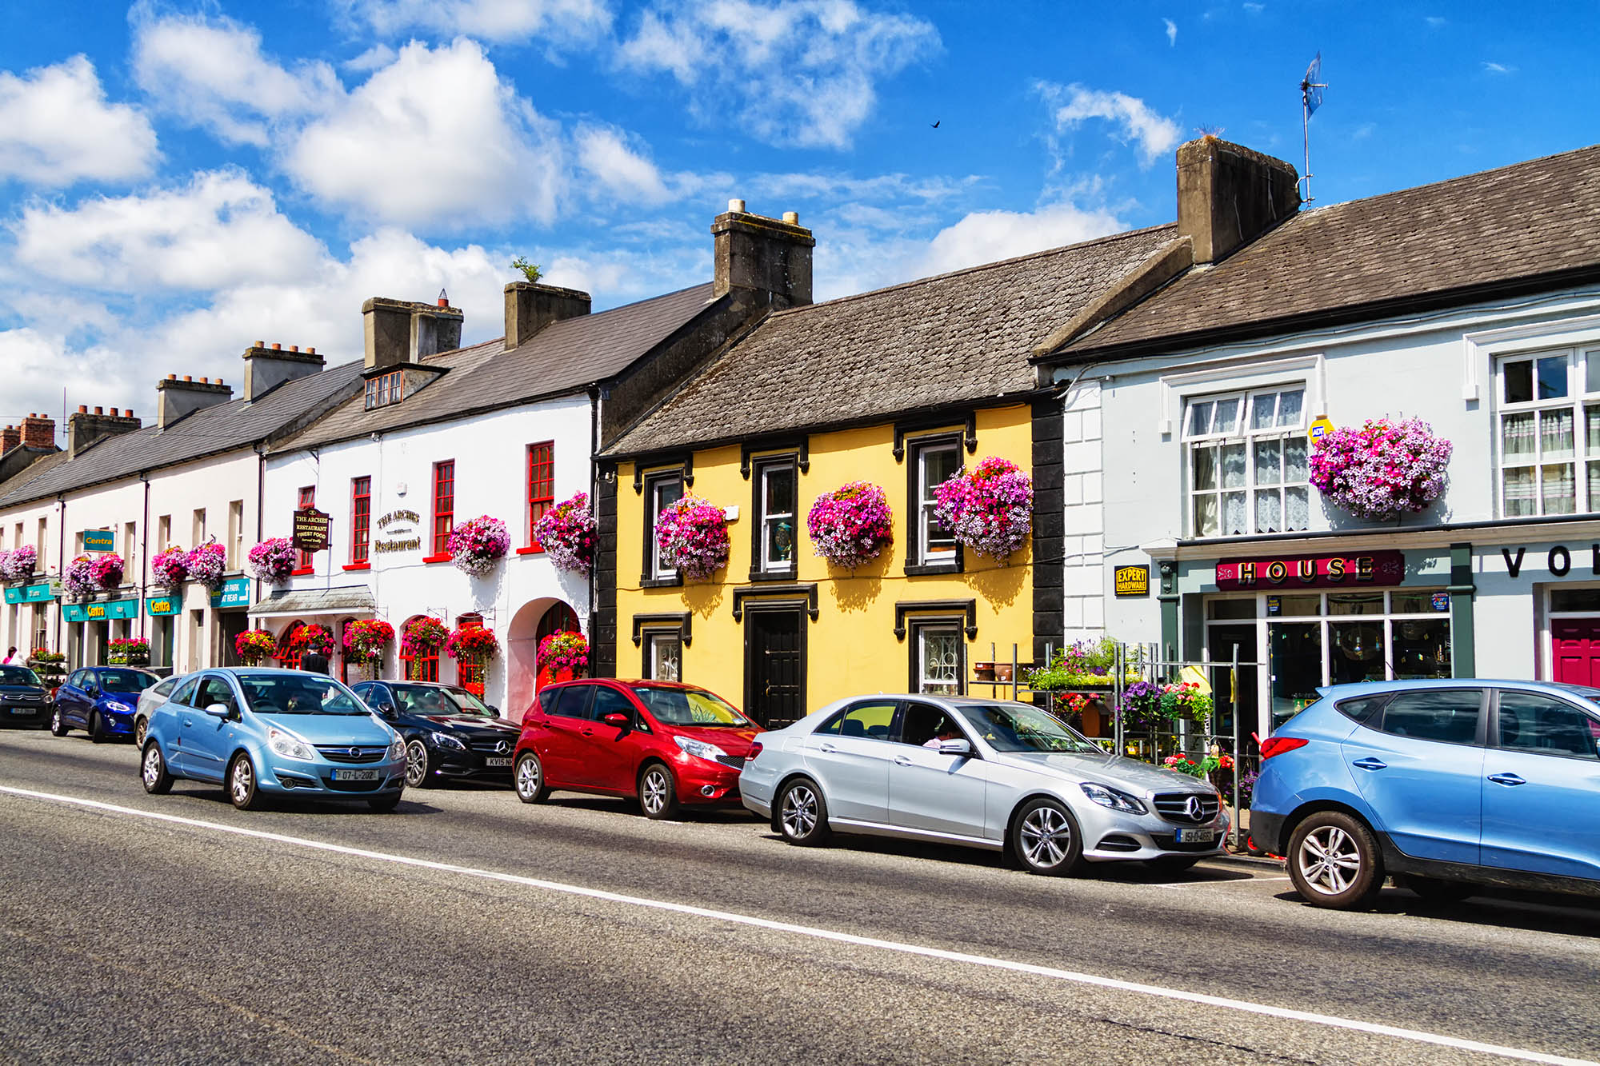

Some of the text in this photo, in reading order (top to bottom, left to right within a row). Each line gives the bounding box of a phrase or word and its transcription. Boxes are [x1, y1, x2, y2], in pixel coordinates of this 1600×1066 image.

[377, 509, 420, 530] THE ARCHES
[86, 537, 113, 545] Centra
[375, 536, 421, 553] Restaurant
[1501, 543, 1600, 578] VO
[1118, 569, 1145, 581] EXPERT
[1238, 557, 1374, 584] HOUSE
[230, 583, 240, 592] PARK
[1117, 581, 1146, 590] HARDWARE
[221, 594, 238, 603] AT REAR
[87, 605, 105, 617] Centra
[151, 600, 171, 613] Centra
